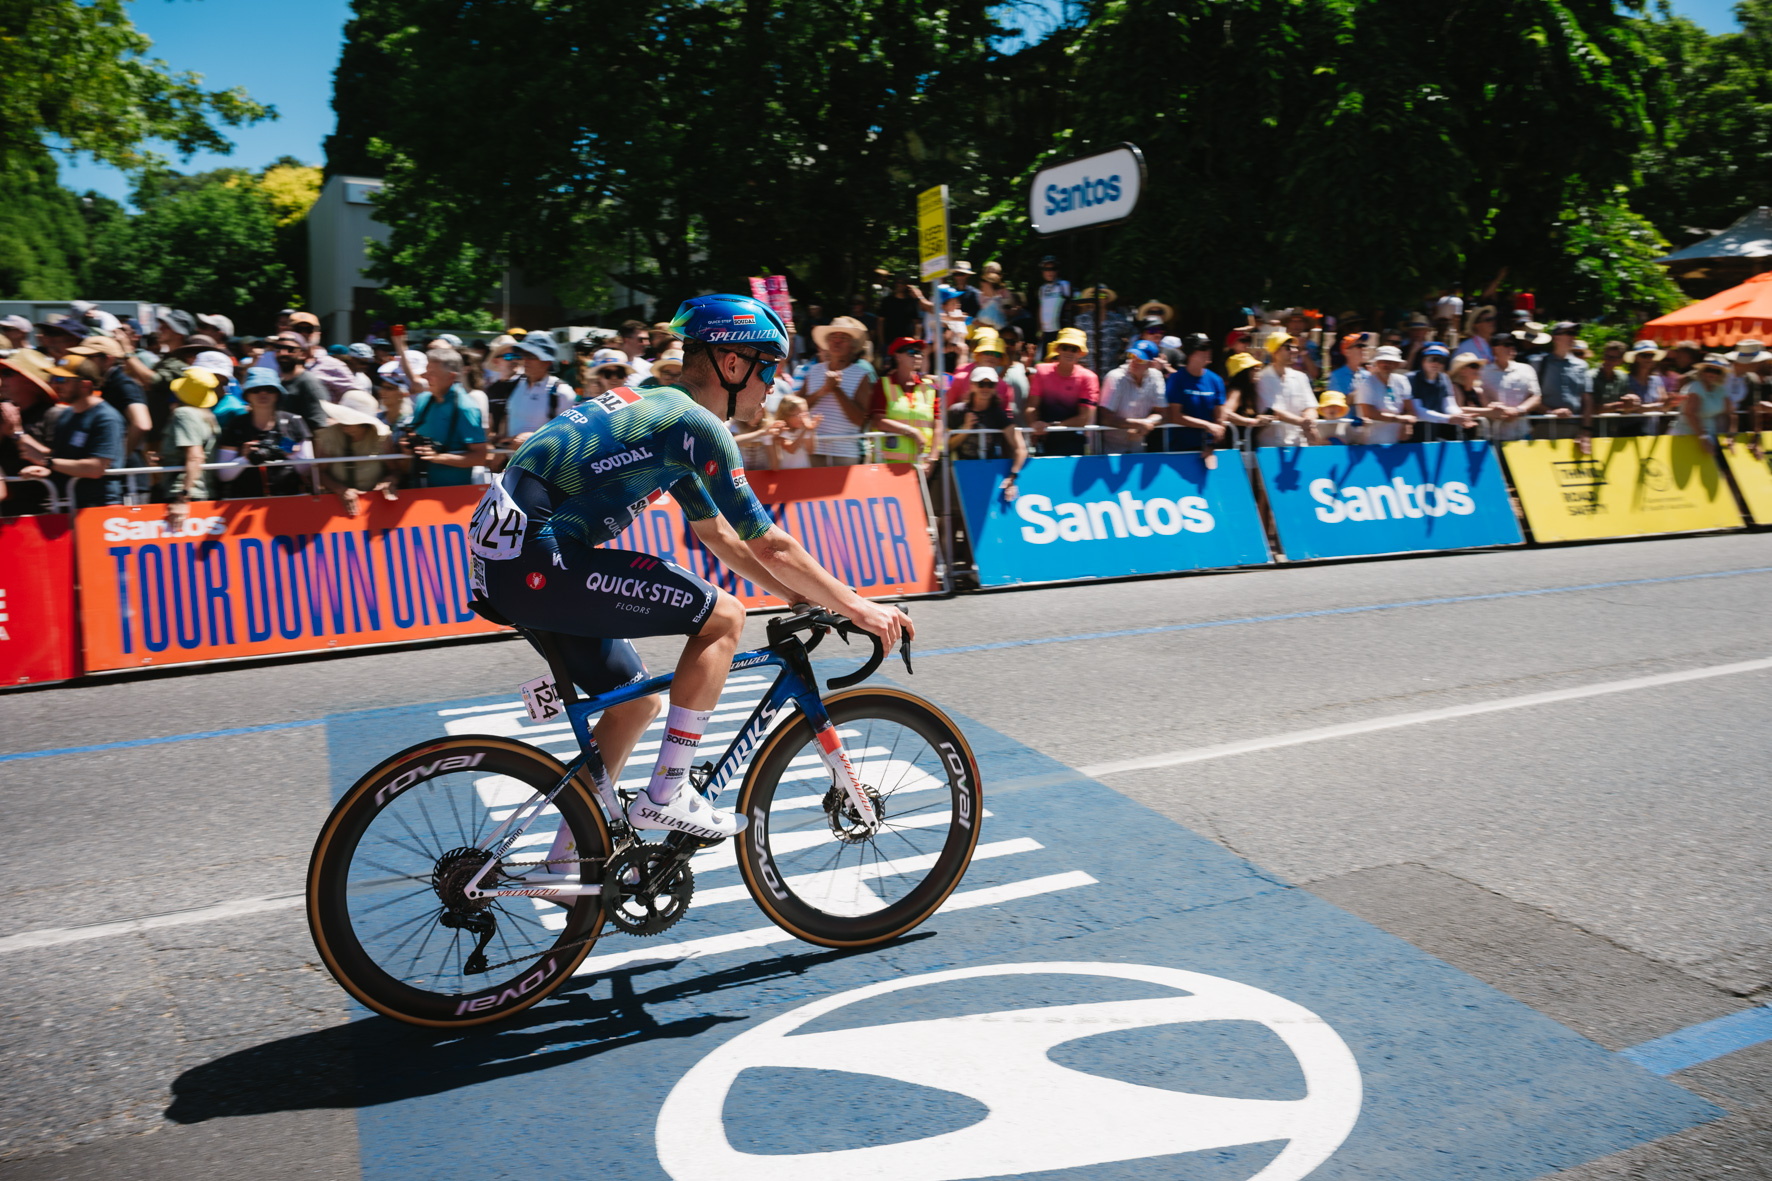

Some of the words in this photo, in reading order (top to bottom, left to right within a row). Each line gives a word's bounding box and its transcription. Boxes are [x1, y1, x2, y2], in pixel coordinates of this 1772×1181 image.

[1045, 174, 1122, 216] Santos
[707, 329, 778, 342] SPECIALIZED
[590, 446, 654, 475] SOUDAL
[1015, 490, 1216, 545] Santos
[1309, 476, 1476, 524] Santos
[103, 516, 228, 541] Sanos
[109, 540, 237, 654] TOUR
[239, 530, 382, 643] DOWN
[382, 523, 476, 629] UND
[692, 590, 713, 623] Ekopak
[615, 602, 651, 615] FLOORS
[730, 654, 770, 669] CIALIZED
[533, 681, 559, 719] 124
[374, 752, 487, 807] roval
[939, 741, 971, 830] roval
[637, 807, 723, 839] SPECIALIZED
[493, 828, 524, 860] SHIMANO
[753, 805, 789, 901] roval
[454, 957, 558, 1015] roval
